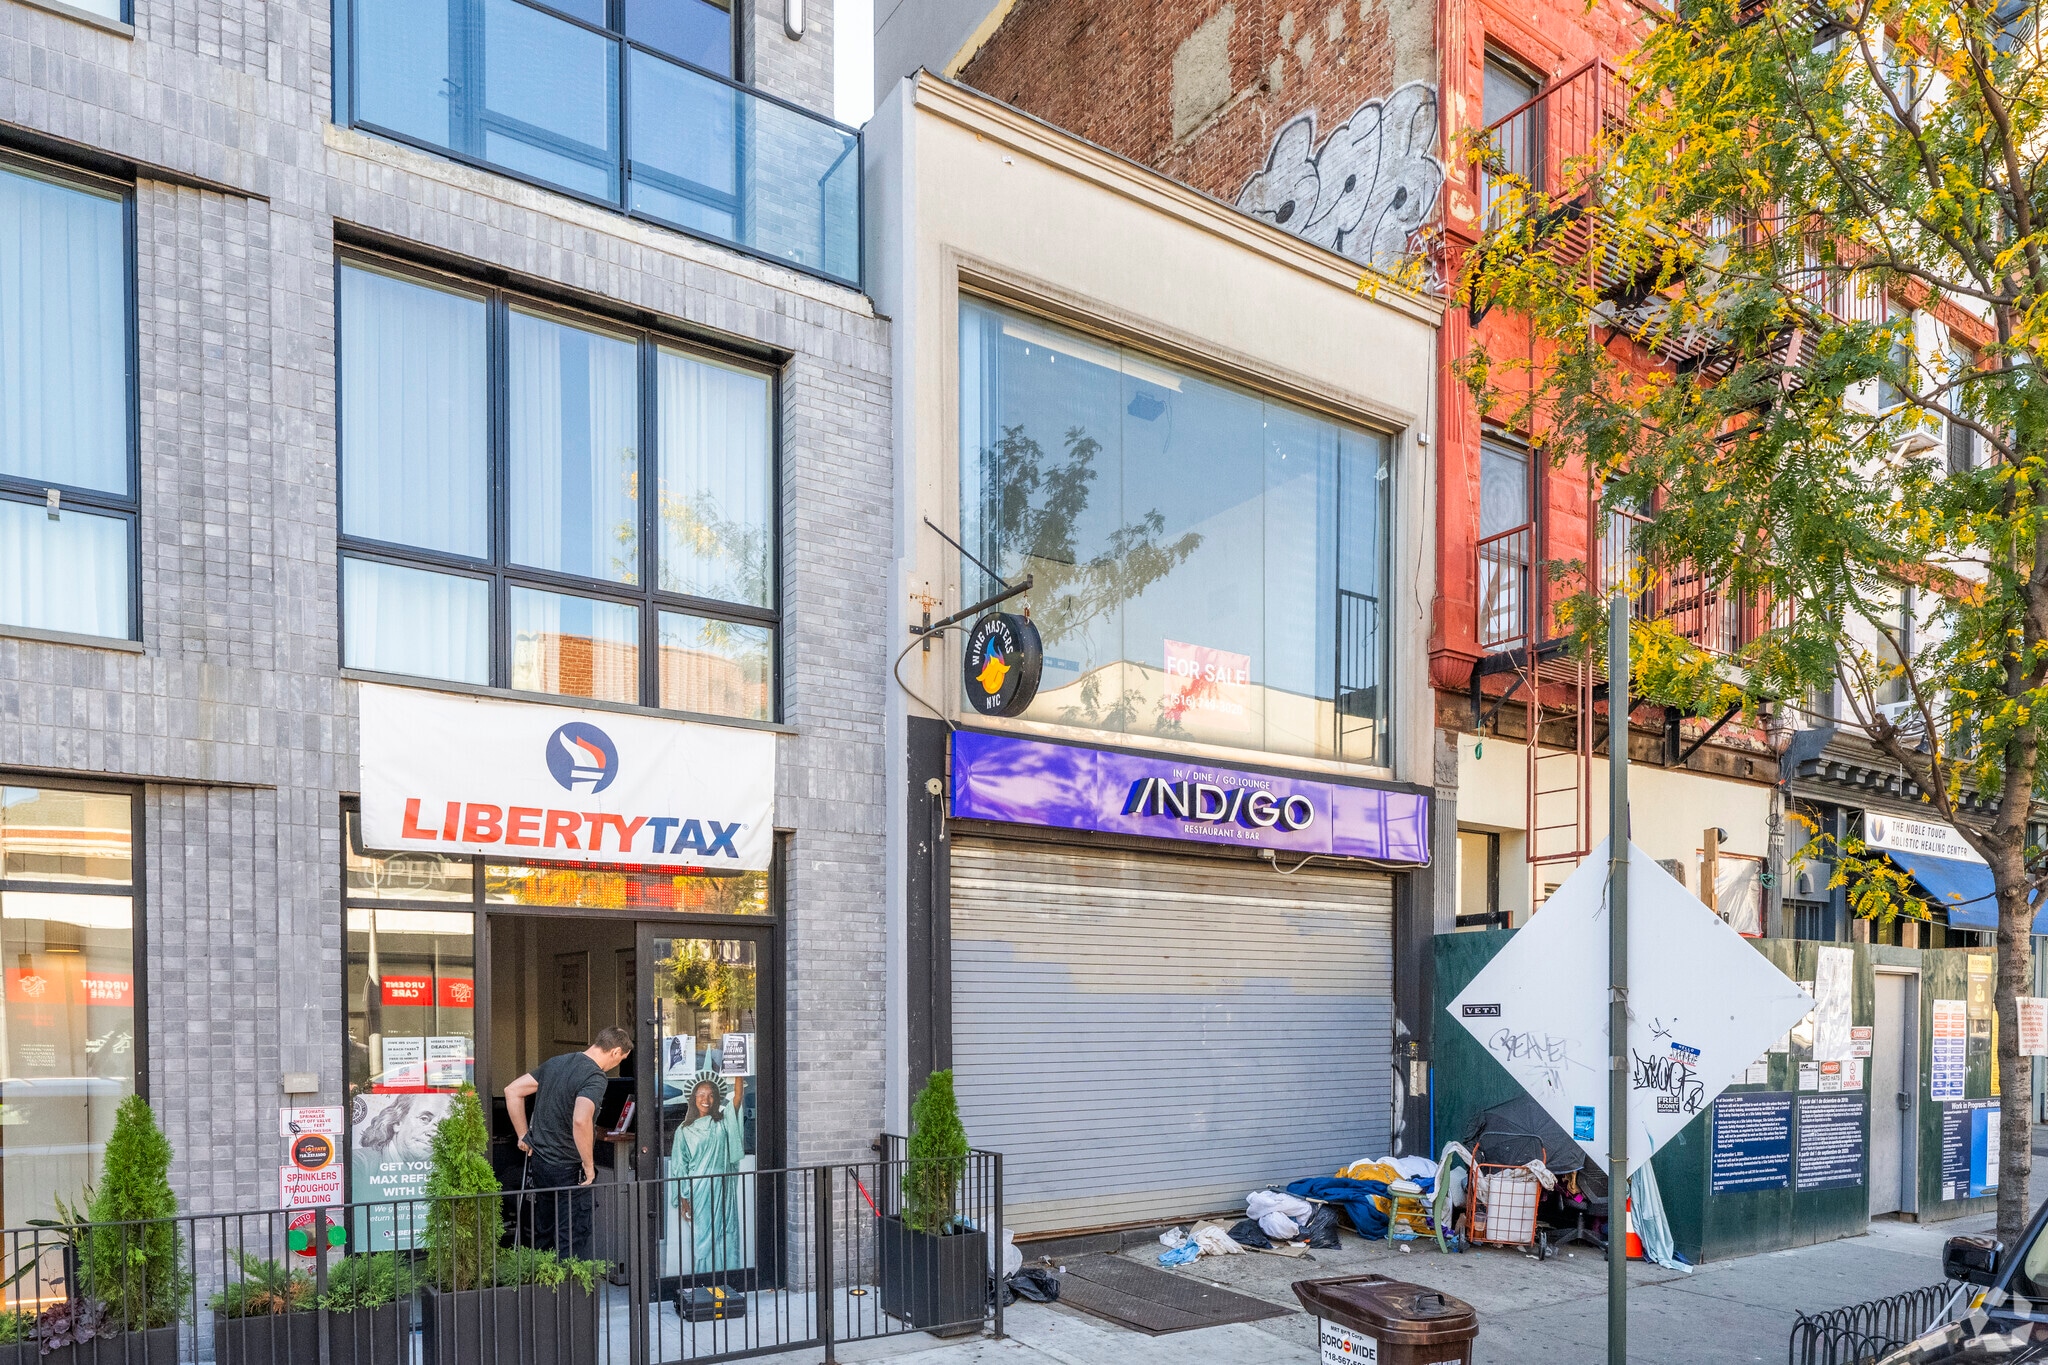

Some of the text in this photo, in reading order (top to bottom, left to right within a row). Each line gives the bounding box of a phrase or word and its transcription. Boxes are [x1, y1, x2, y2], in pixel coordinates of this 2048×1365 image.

[972, 620, 1014, 666] WING MASTERS
[1166, 655, 1247, 689] FOR SALE
[986, 693, 1001, 709] NYC
[1173, 769, 1183, 778] IN
[1193, 771, 1213, 782] DINE
[1184, 824, 1234, 838] RESTAURANT
[1245, 830, 1260, 840] BAR
[1892, 821, 1946, 839] THE NOBLE TOUCH
[1891, 836, 1968, 857] HOLISTIC HEALING CENTER
[363, 860, 447, 886] OPEN
[380, 1162, 434, 1171] GET YOU
[287, 1172, 337, 1182] SPRINKLERS
[370, 1174, 432, 1184] MAX REFU
[284, 1183, 340, 1193] THROUGHOUT
[383, 1187, 415, 1196] WITH
[294, 1194, 331, 1204] BUILDING
[295, 1214, 310, 1226] AUTO
[1322, 1332, 1375, 1360] BORO WIDE
